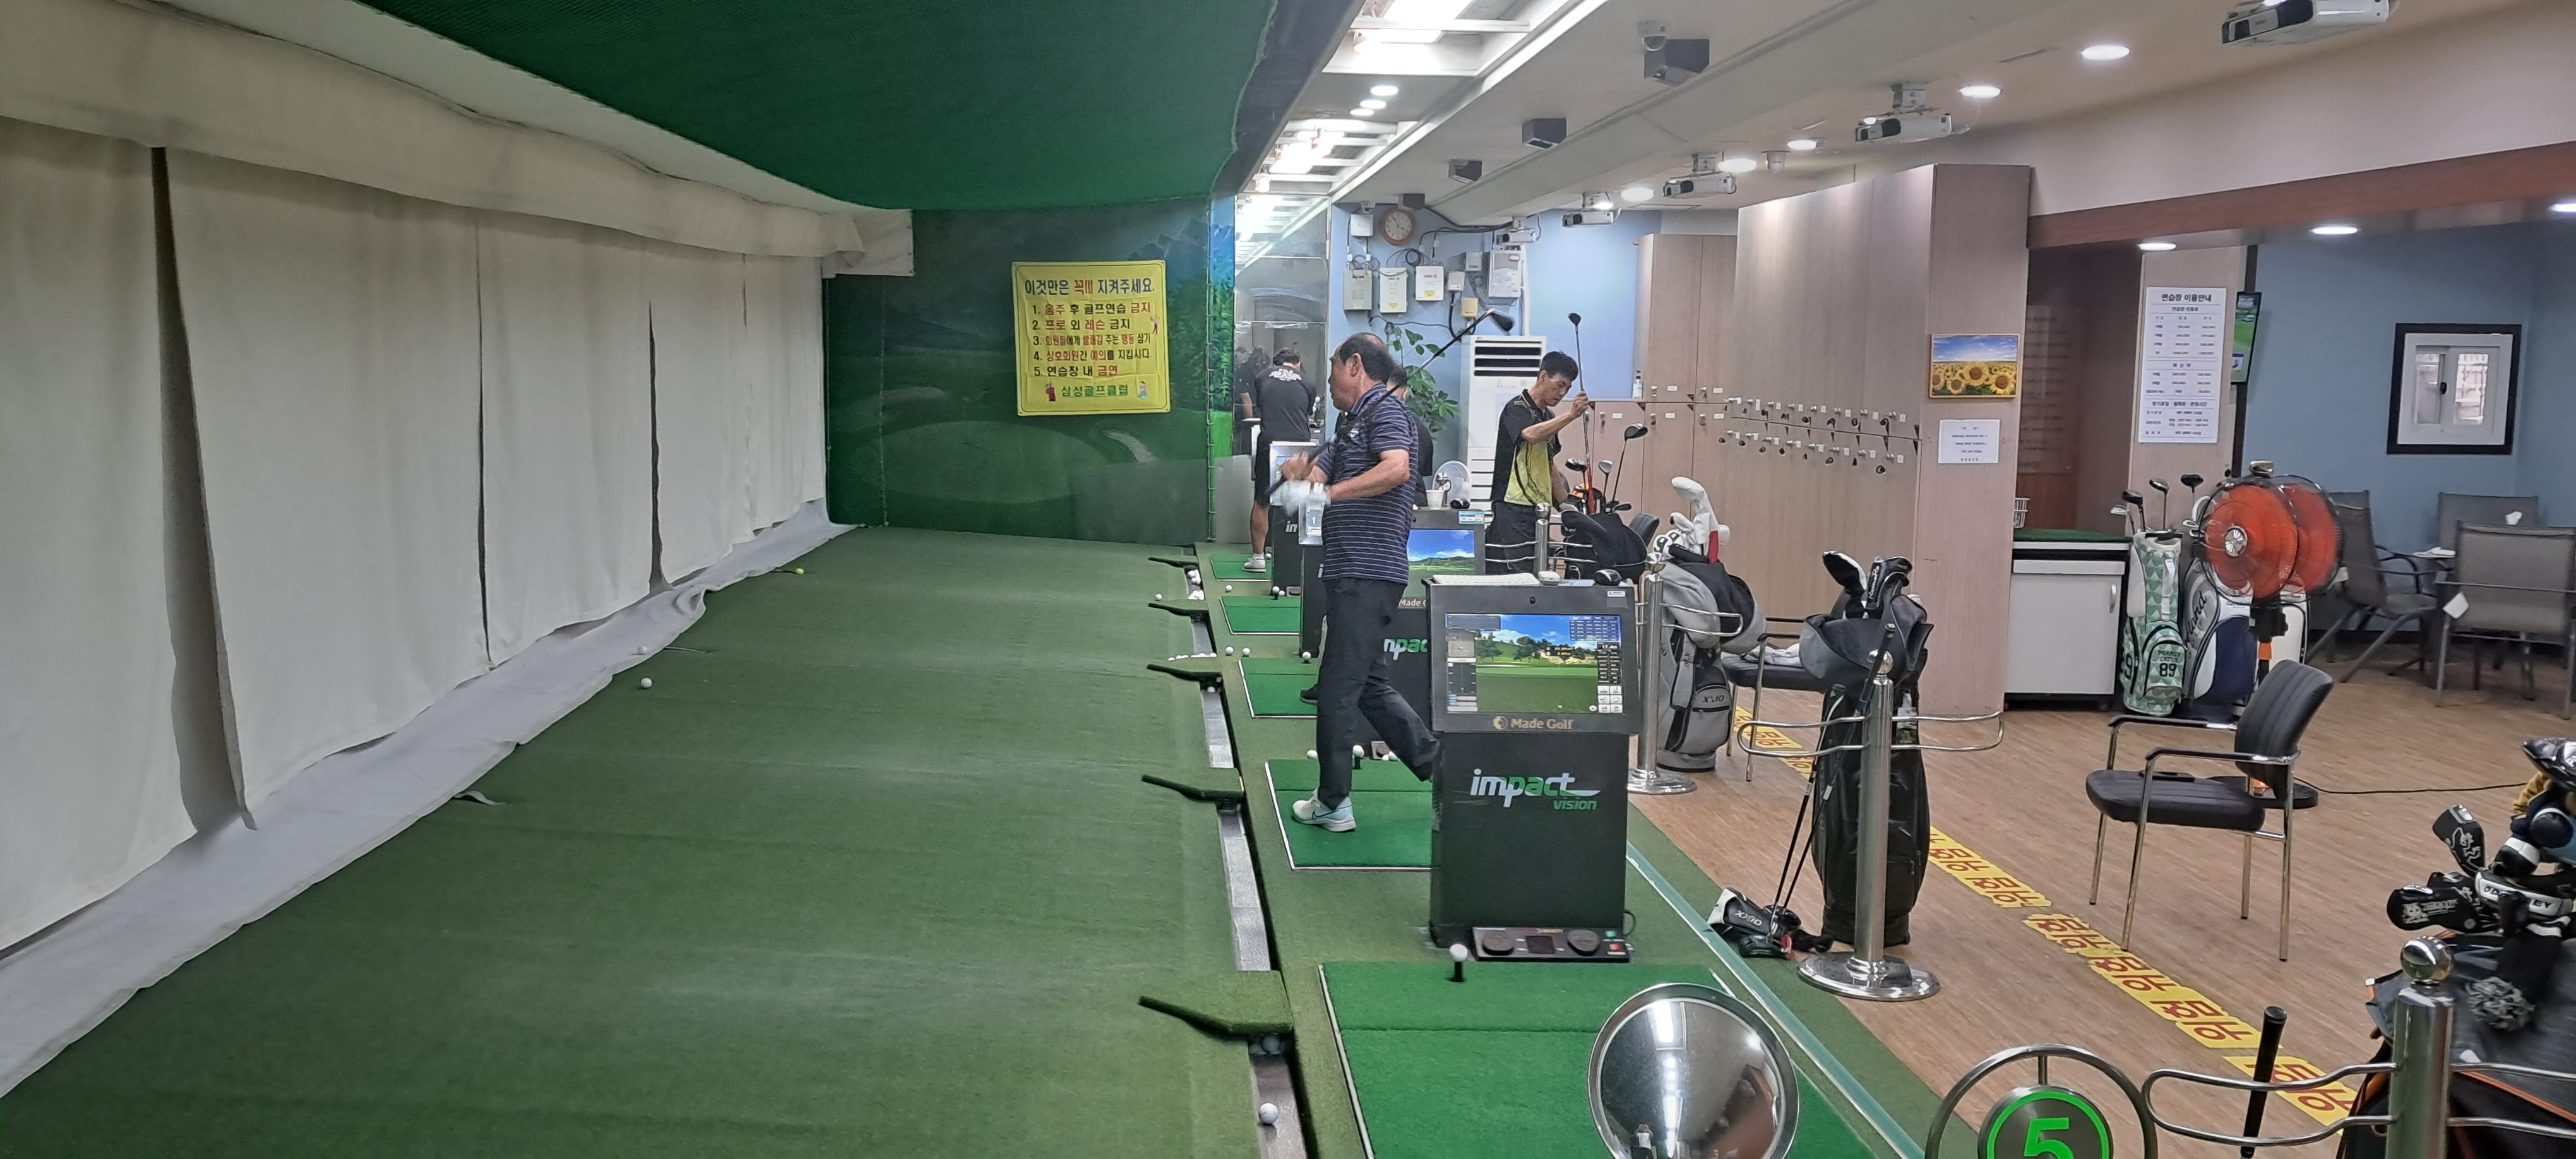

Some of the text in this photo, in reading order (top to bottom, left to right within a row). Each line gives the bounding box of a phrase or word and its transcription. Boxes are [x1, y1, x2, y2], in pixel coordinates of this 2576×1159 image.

[1025, 280, 1070, 295] 이것만은
[1097, 278, 1155, 295] 지켜주세요.
[2161, 294, 2212, 302] 연습장 이용안내
[1032, 302, 1150, 316] 1. 음주 후 골프연습 금지
[1032, 318, 1130, 331] 2. 프로 외 레슨 금지
[1033, 335, 1042, 346] 3.
[1046, 335, 1080, 346] 회원들에게
[1106, 334, 1119, 345] 주는
[1121, 334, 1135, 345] 행동
[1034, 348, 1152, 362] 4. 상호회원간 예의를 지킵시다.
[1034, 365, 1118, 377] 5. 연습장 내 금연
[1061, 384, 1129, 397] 삼성골프클럽
[2159, 663, 2177, 677] 89
[1510, 718, 1574, 730] Made Golf
[1470, 768, 1601, 808] impact
[1553, 797, 1598, 810] vision
[1734, 910, 1763, 926] XXIO
[2089, 956, 2178, 992] 위험
[2149, 1000, 2254, 1041] 위험
[2024, 1117, 2074, 1159] 5
